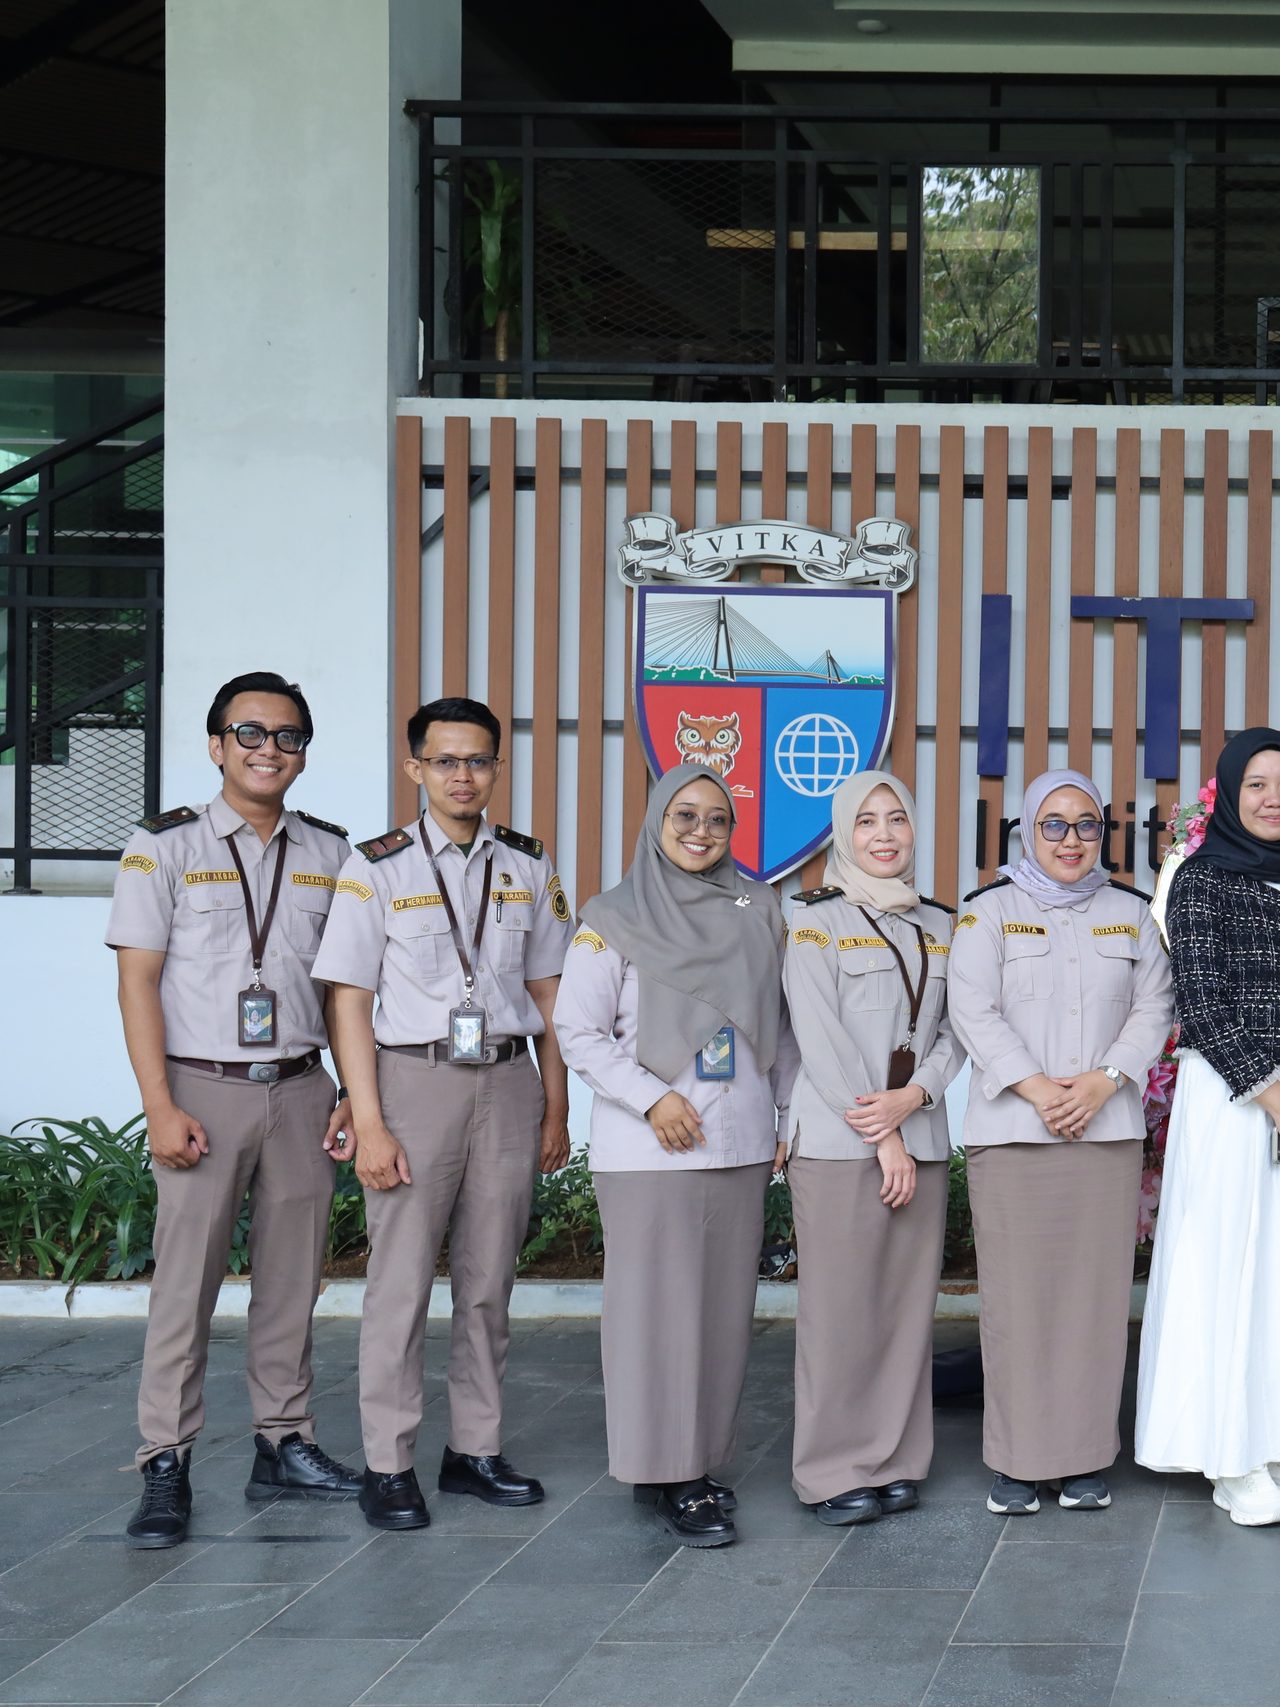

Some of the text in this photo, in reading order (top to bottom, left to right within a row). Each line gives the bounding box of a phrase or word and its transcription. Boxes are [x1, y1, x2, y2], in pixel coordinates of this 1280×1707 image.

[706, 532, 824, 557] VITKA
[187, 872, 238, 884] RIZKI AKBAR
[395, 900, 404, 910] AP
[1004, 925, 1037, 933] NOVITA
